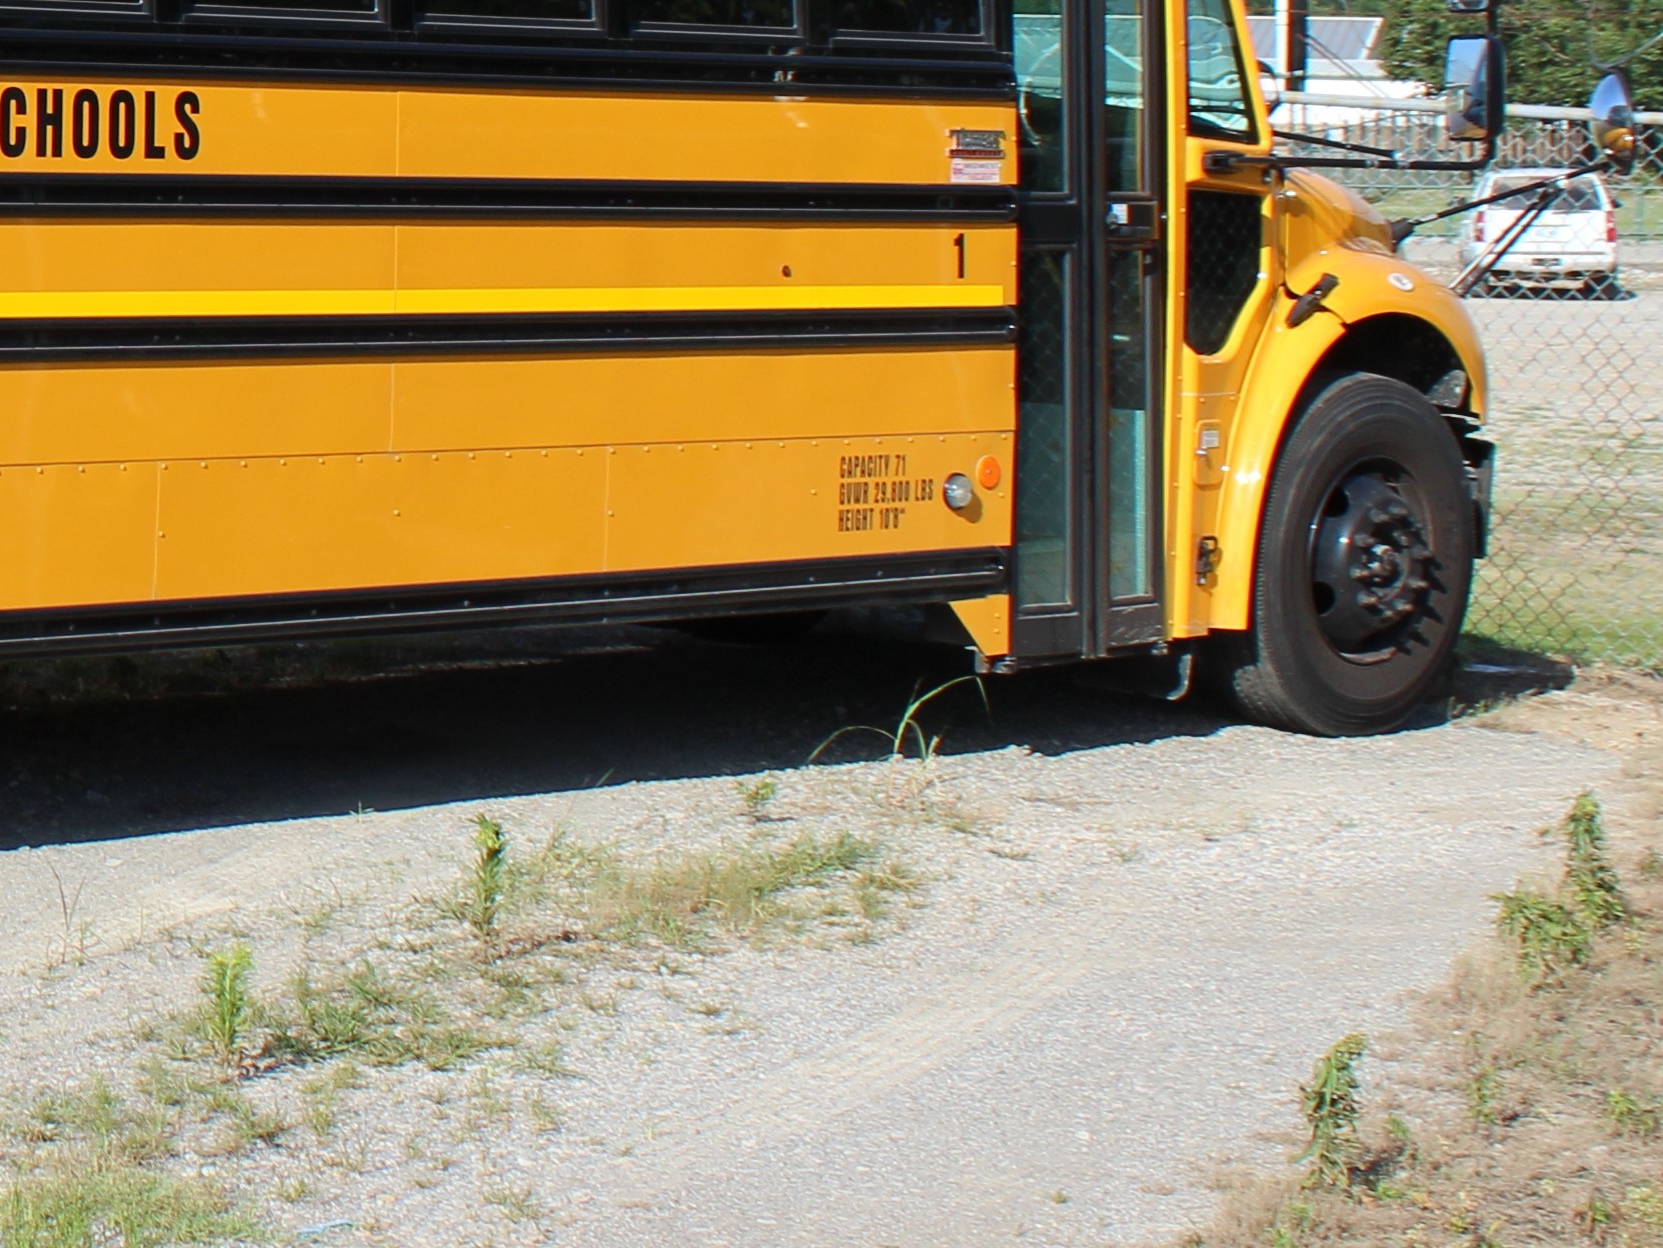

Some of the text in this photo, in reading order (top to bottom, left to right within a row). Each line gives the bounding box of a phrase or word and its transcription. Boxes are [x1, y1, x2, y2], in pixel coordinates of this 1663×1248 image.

[953, 233, 966, 279] 1
[839, 454, 906, 479] CAPACITY 71
[839, 479, 933, 505] GVWR 29,800 LBS
[838, 508, 874, 532] HEIGHT
